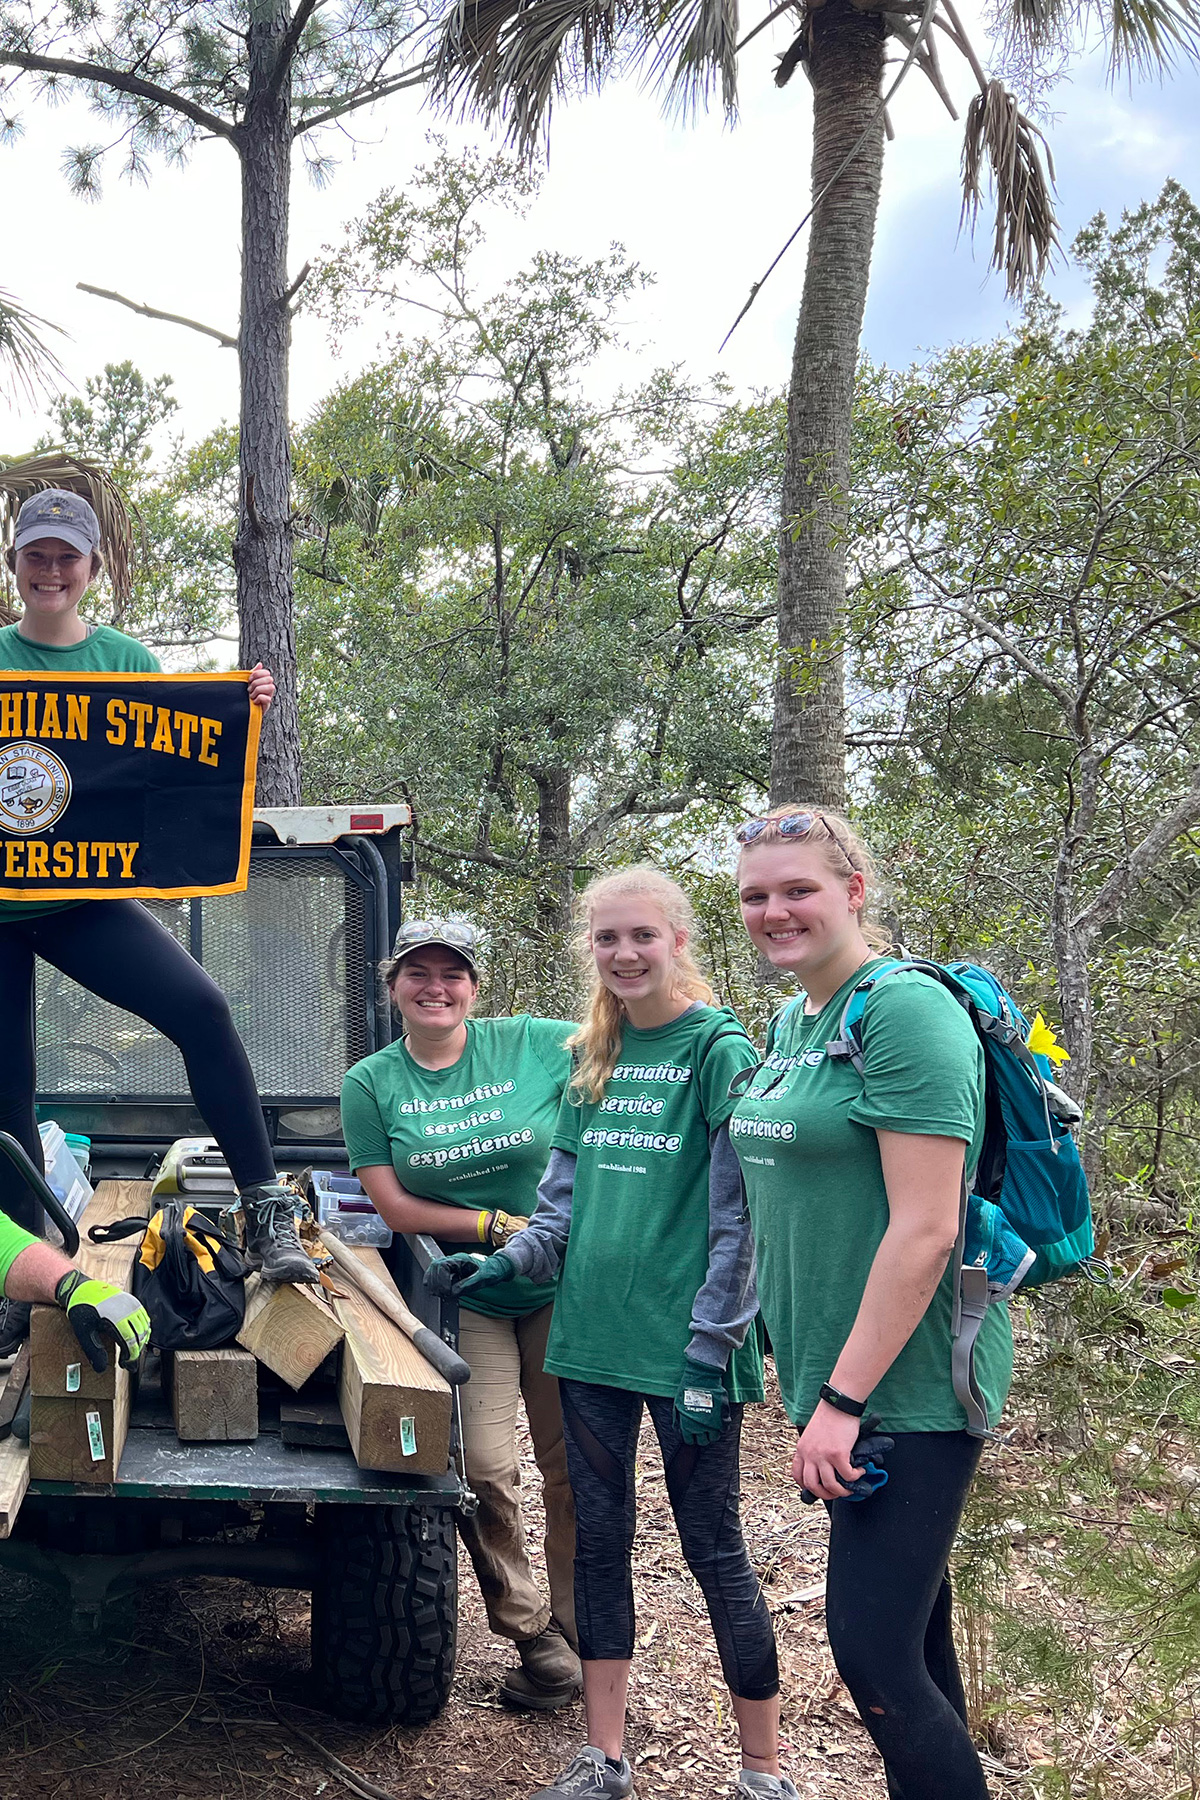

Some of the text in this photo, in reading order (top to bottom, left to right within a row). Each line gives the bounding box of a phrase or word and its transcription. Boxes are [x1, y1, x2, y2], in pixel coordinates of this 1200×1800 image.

[106, 699, 223, 767] STATE
[13, 748, 43, 760] STATE
[45, 759, 64, 815] UNIVERSITY
[16, 819, 36, 828] 1899
[611, 1062, 692, 1082] ernative
[399, 1079, 516, 1115] alternative
[599, 1093, 665, 1115] service
[423, 1108, 503, 1137] service
[729, 1115, 796, 1140] xperience
[408, 1128, 534, 1168] experience
[448, 1167, 491, 1183] established
